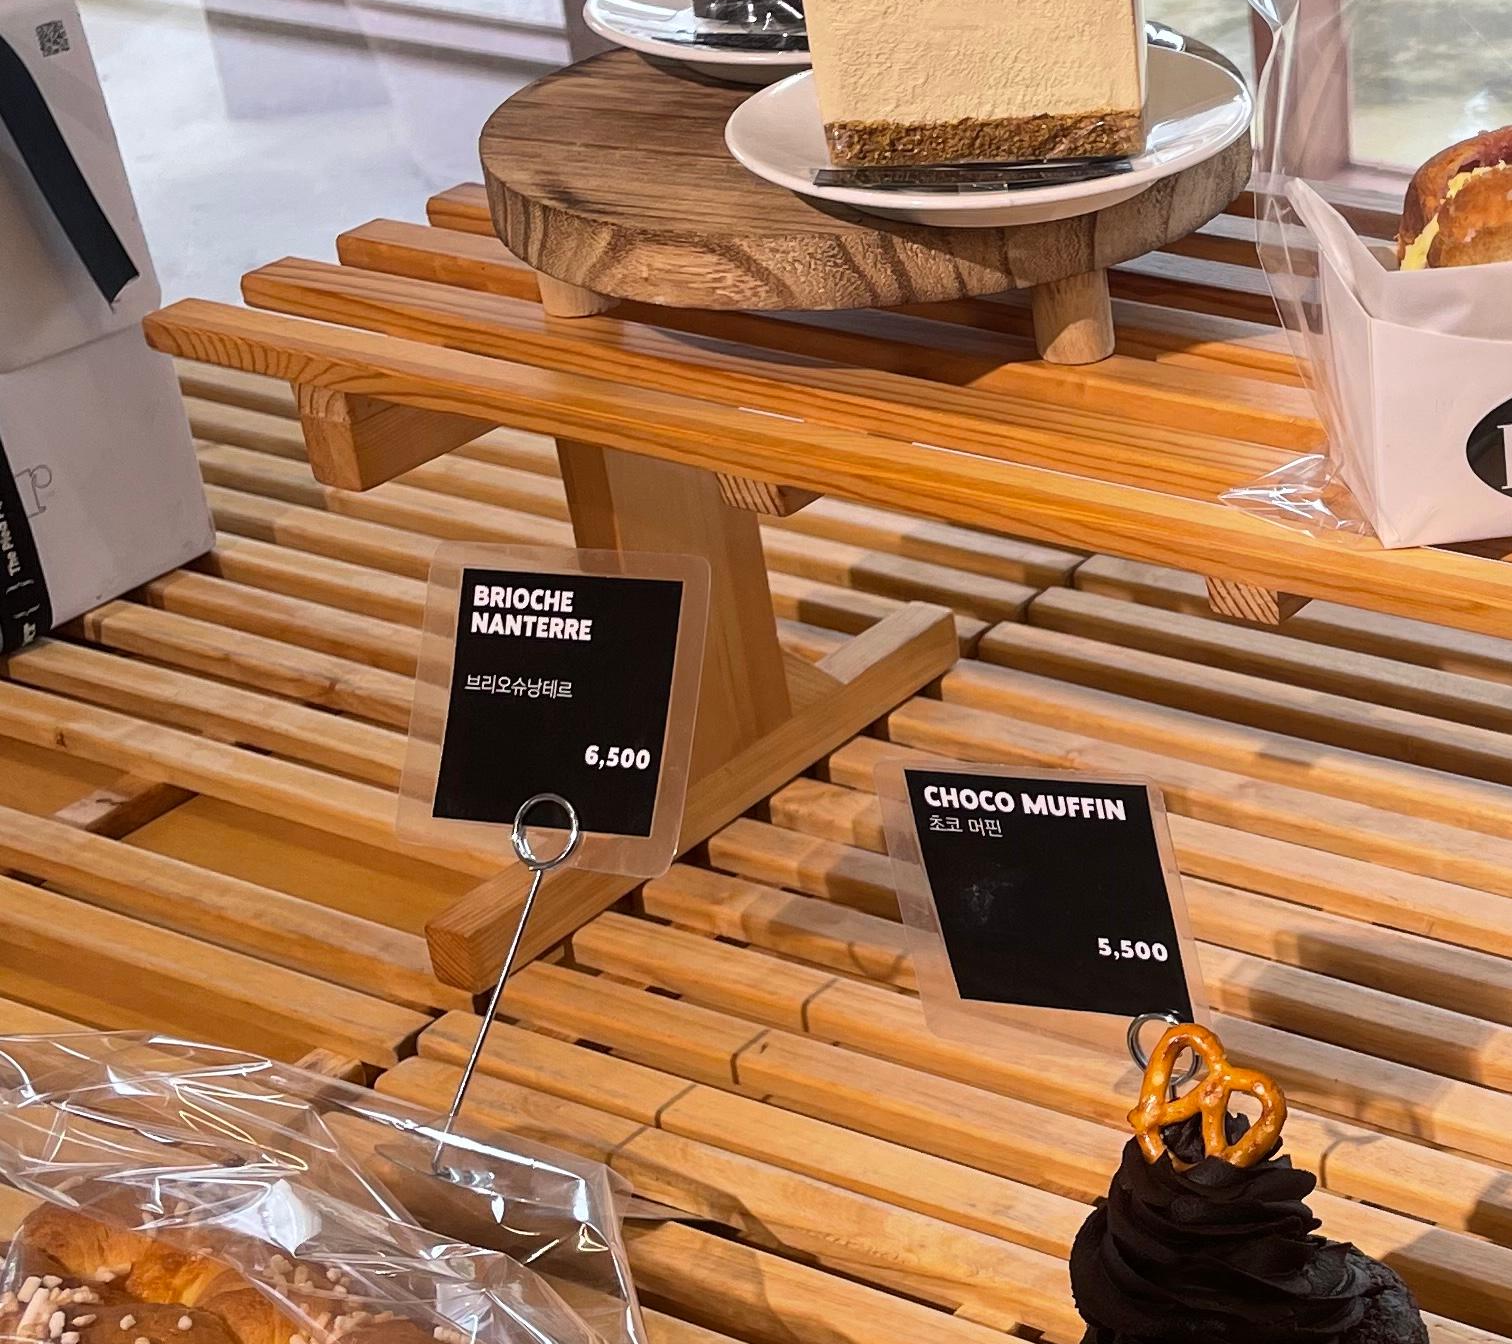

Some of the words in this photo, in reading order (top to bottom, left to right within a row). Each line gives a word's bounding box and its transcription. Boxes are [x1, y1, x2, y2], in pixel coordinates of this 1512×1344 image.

[473, 585, 574, 613] BRIOCHE
[471, 612, 592, 641] NANTERRE
[465, 675, 573, 698] 브리오슈낭테르
[585, 745, 650, 770] 6,500
[924, 786, 1015, 812] CHOCO
[1021, 793, 1126, 820] MUFFIN
[929, 815, 963, 832] 초코
[968, 818, 1003, 838] 머핀
[1098, 938, 1168, 962] 5,500
